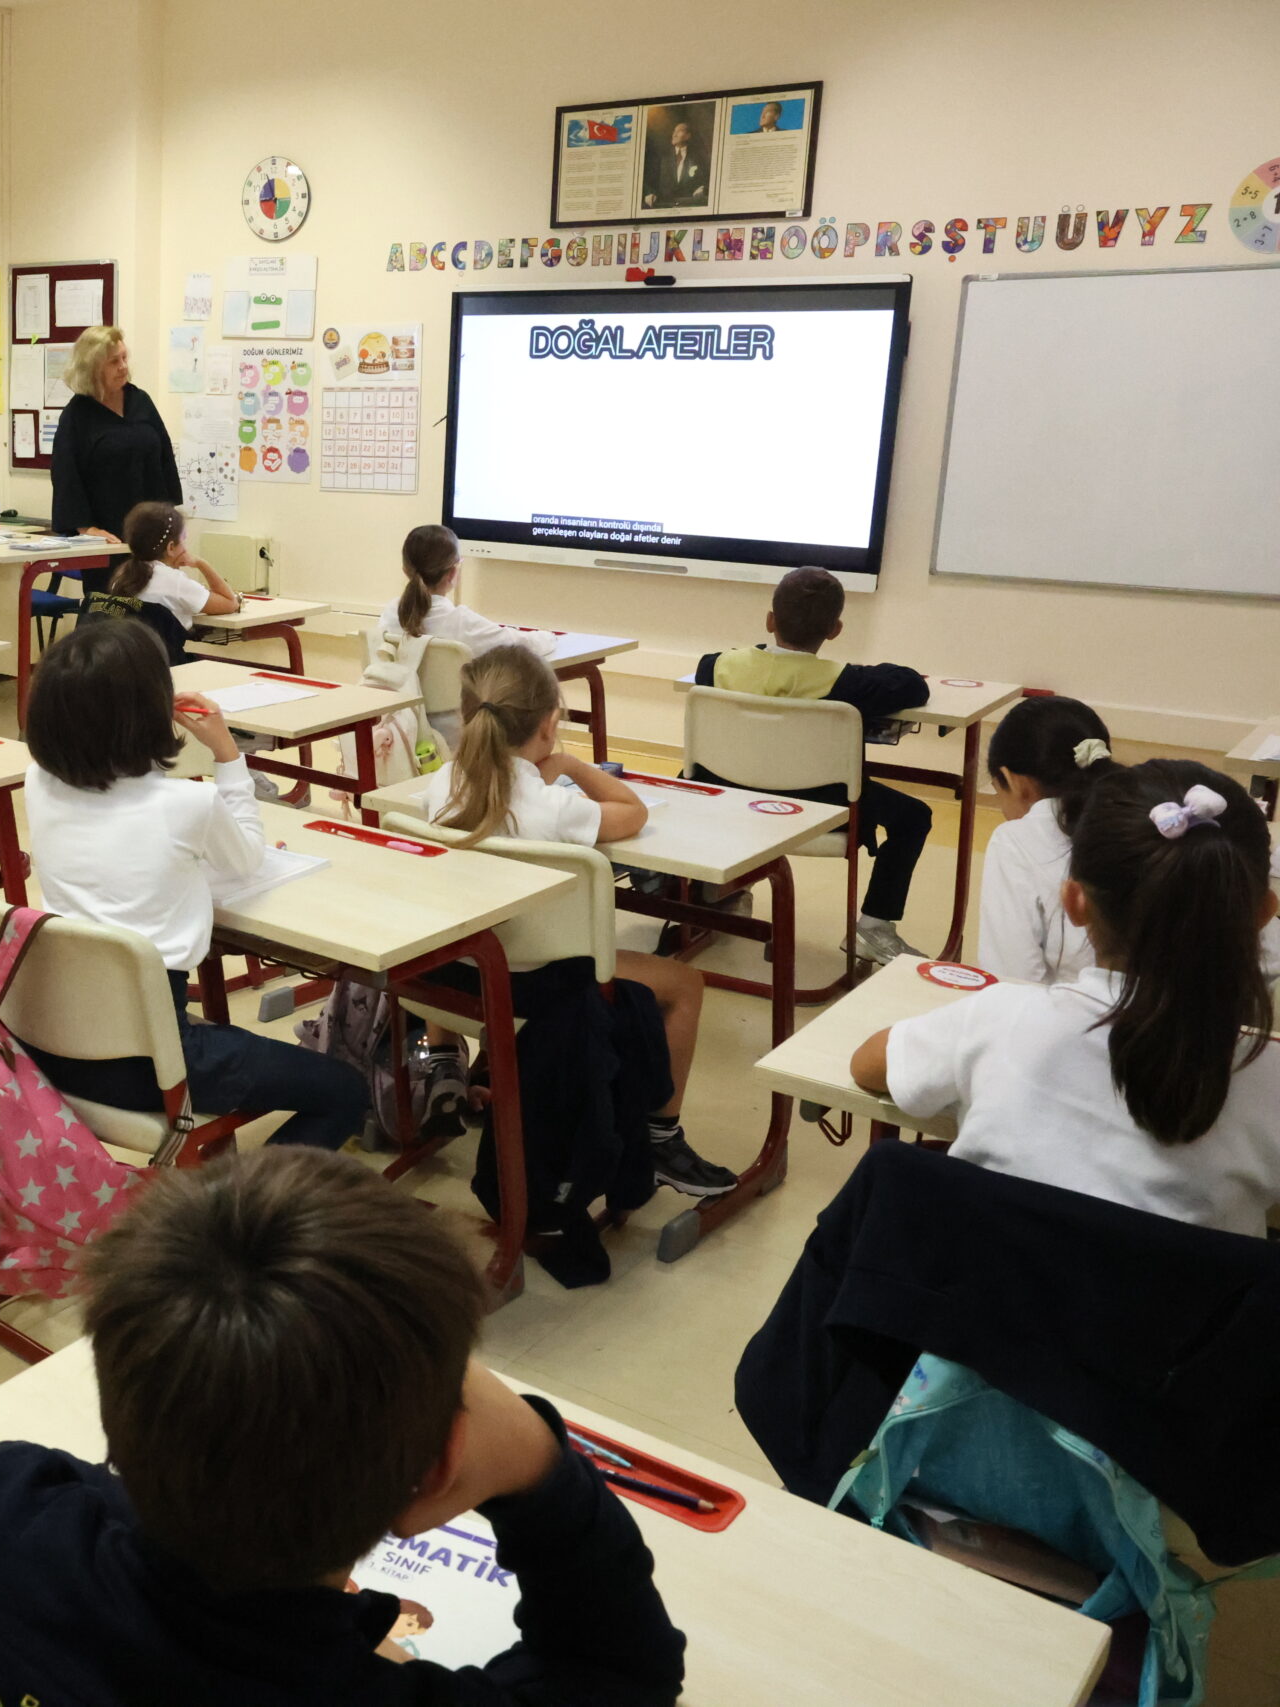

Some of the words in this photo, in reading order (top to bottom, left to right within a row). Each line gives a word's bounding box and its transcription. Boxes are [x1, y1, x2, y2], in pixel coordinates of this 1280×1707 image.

[530, 320, 633, 359] DOĞAL
[636, 325, 774, 360] AFETLER
[243, 348, 264, 356] DOĞUM
[266, 347, 303, 355] GÜNLERİMİZ
[533, 516, 559, 525] oranda
[599, 520, 630, 530] kontrolü
[532, 527, 577, 538] gerçekleşen
[579, 530, 608, 540] olaylara
[610, 532, 631, 542] doğal
[634, 534, 659, 544] afetler
[661, 537, 681, 545] denir
[383, 1551, 432, 1575] SINIF
[380, 1566, 409, 1581] KİTAP
